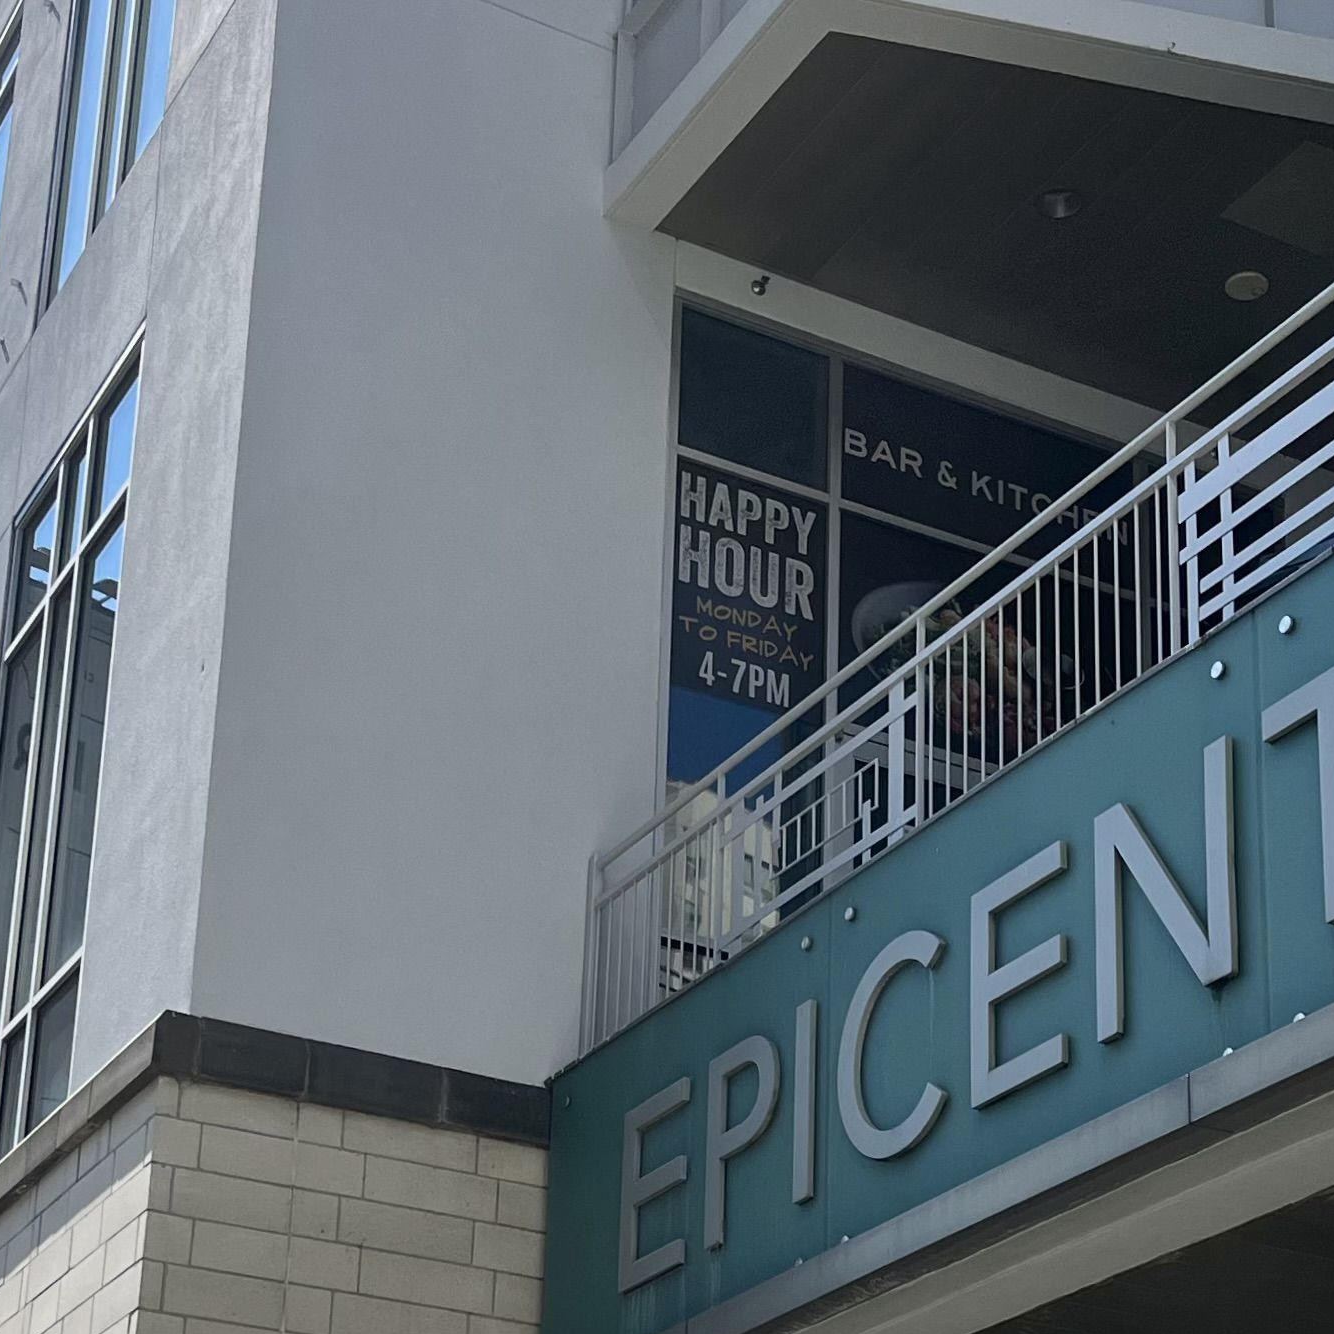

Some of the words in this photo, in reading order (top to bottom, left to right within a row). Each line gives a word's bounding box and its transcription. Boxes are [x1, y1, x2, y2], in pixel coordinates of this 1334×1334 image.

[844, 427, 924, 479] BAR
[937, 460, 959, 491] &
[680, 470, 817, 556] HAPPY
[677, 523, 815, 622] HOUR
[679, 615, 718, 643] TO
[726, 630, 814, 674] FRIDAY
[695, 596, 799, 641] MONDAY
[698, 650, 791, 709] 4-7PM
